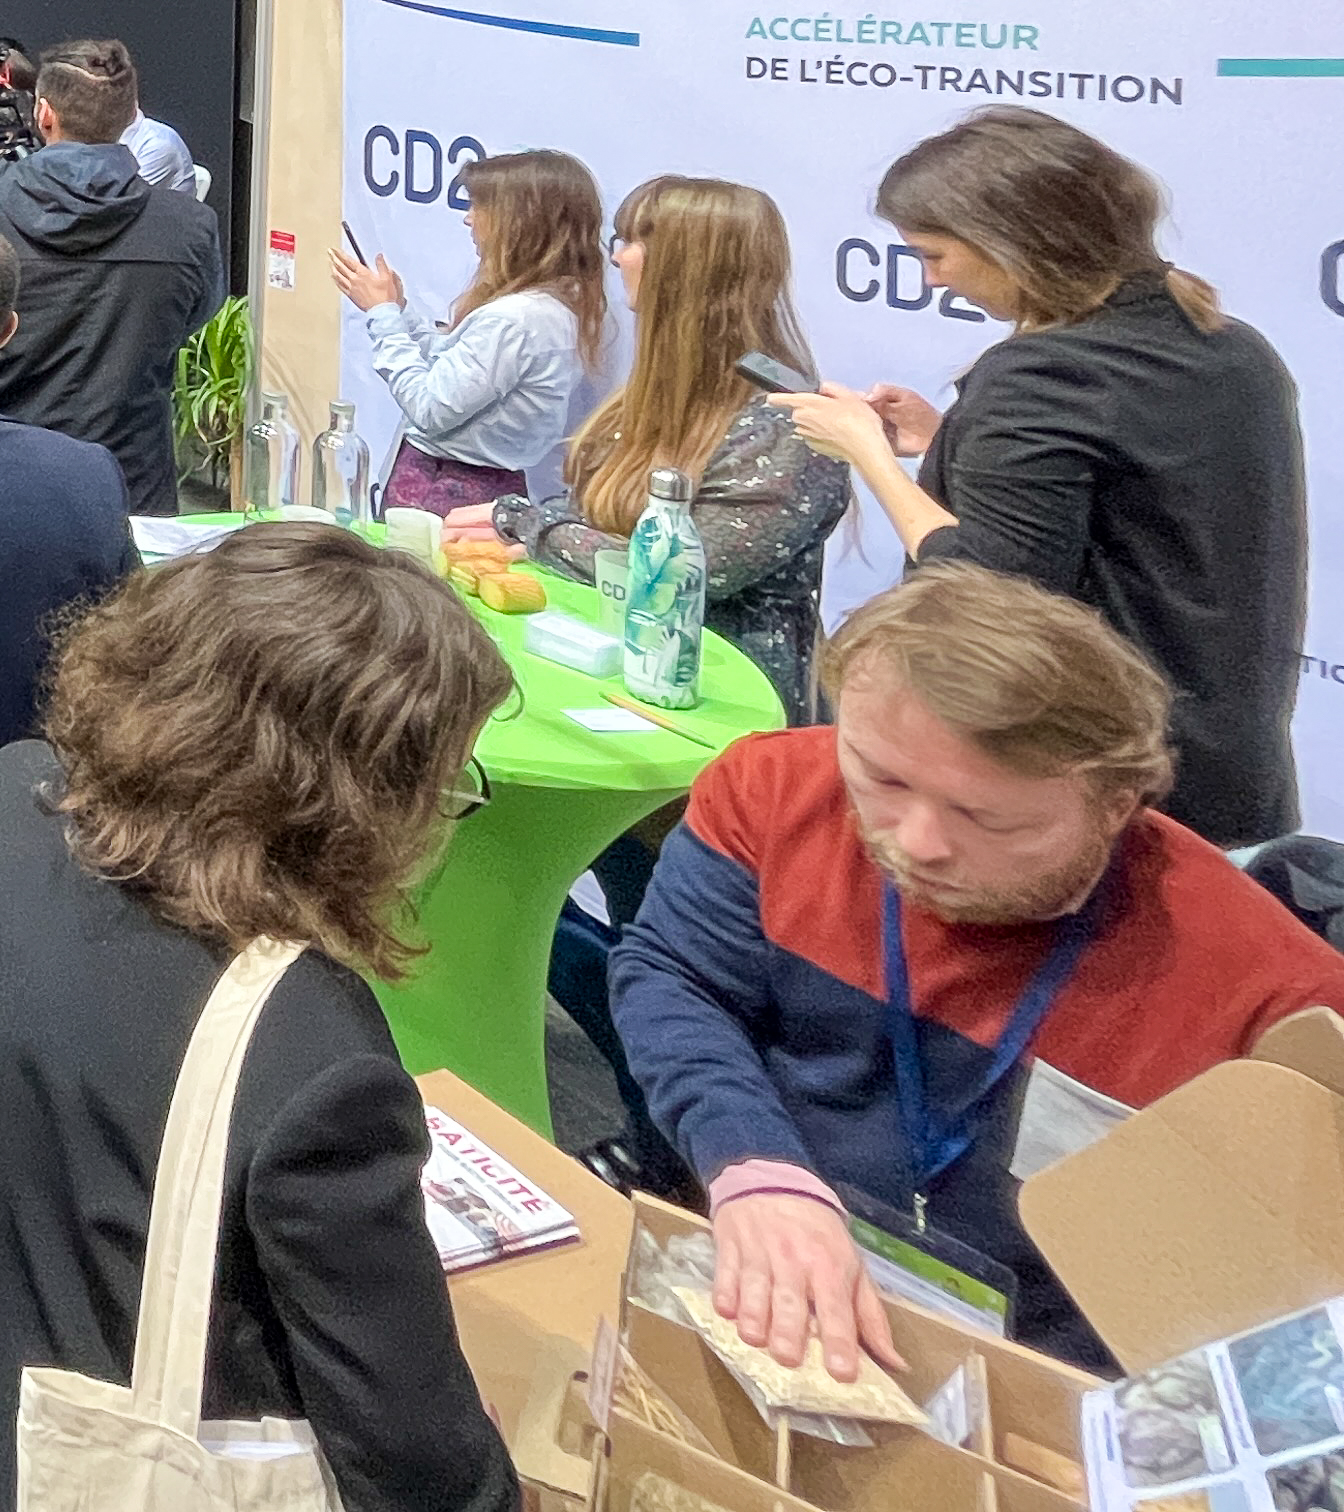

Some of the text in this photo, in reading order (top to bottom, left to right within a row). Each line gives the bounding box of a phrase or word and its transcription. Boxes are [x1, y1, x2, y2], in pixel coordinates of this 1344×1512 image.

[744, 11, 1041, 51] ACCÉLÉRATEUR
[745, 56, 789, 81] DE
[363, 124, 487, 212] CD2
